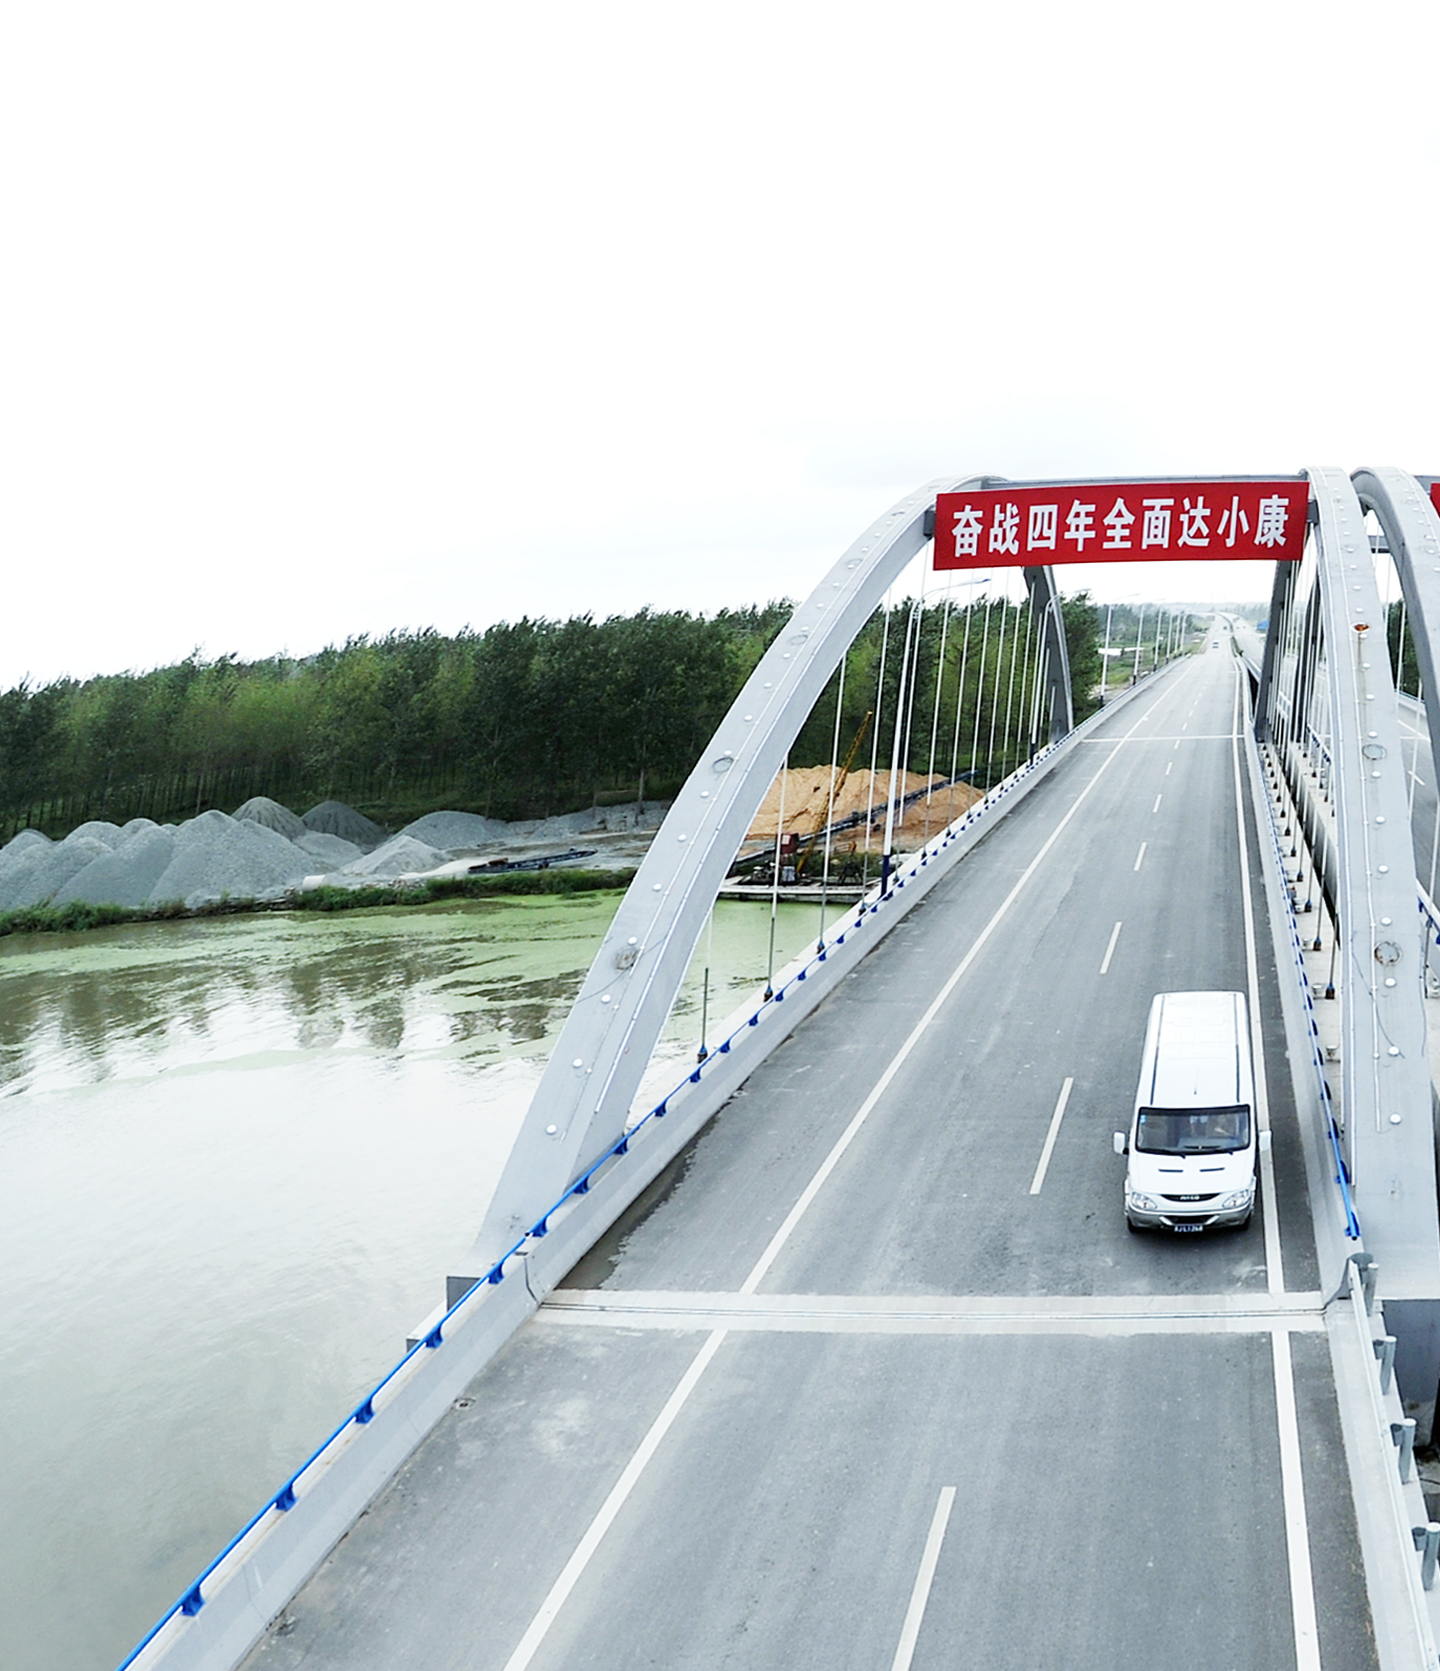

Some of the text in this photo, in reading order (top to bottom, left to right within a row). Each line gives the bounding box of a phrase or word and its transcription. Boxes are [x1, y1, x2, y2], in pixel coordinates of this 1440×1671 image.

[951, 494, 1290, 558] 奋战四年全面达小康
